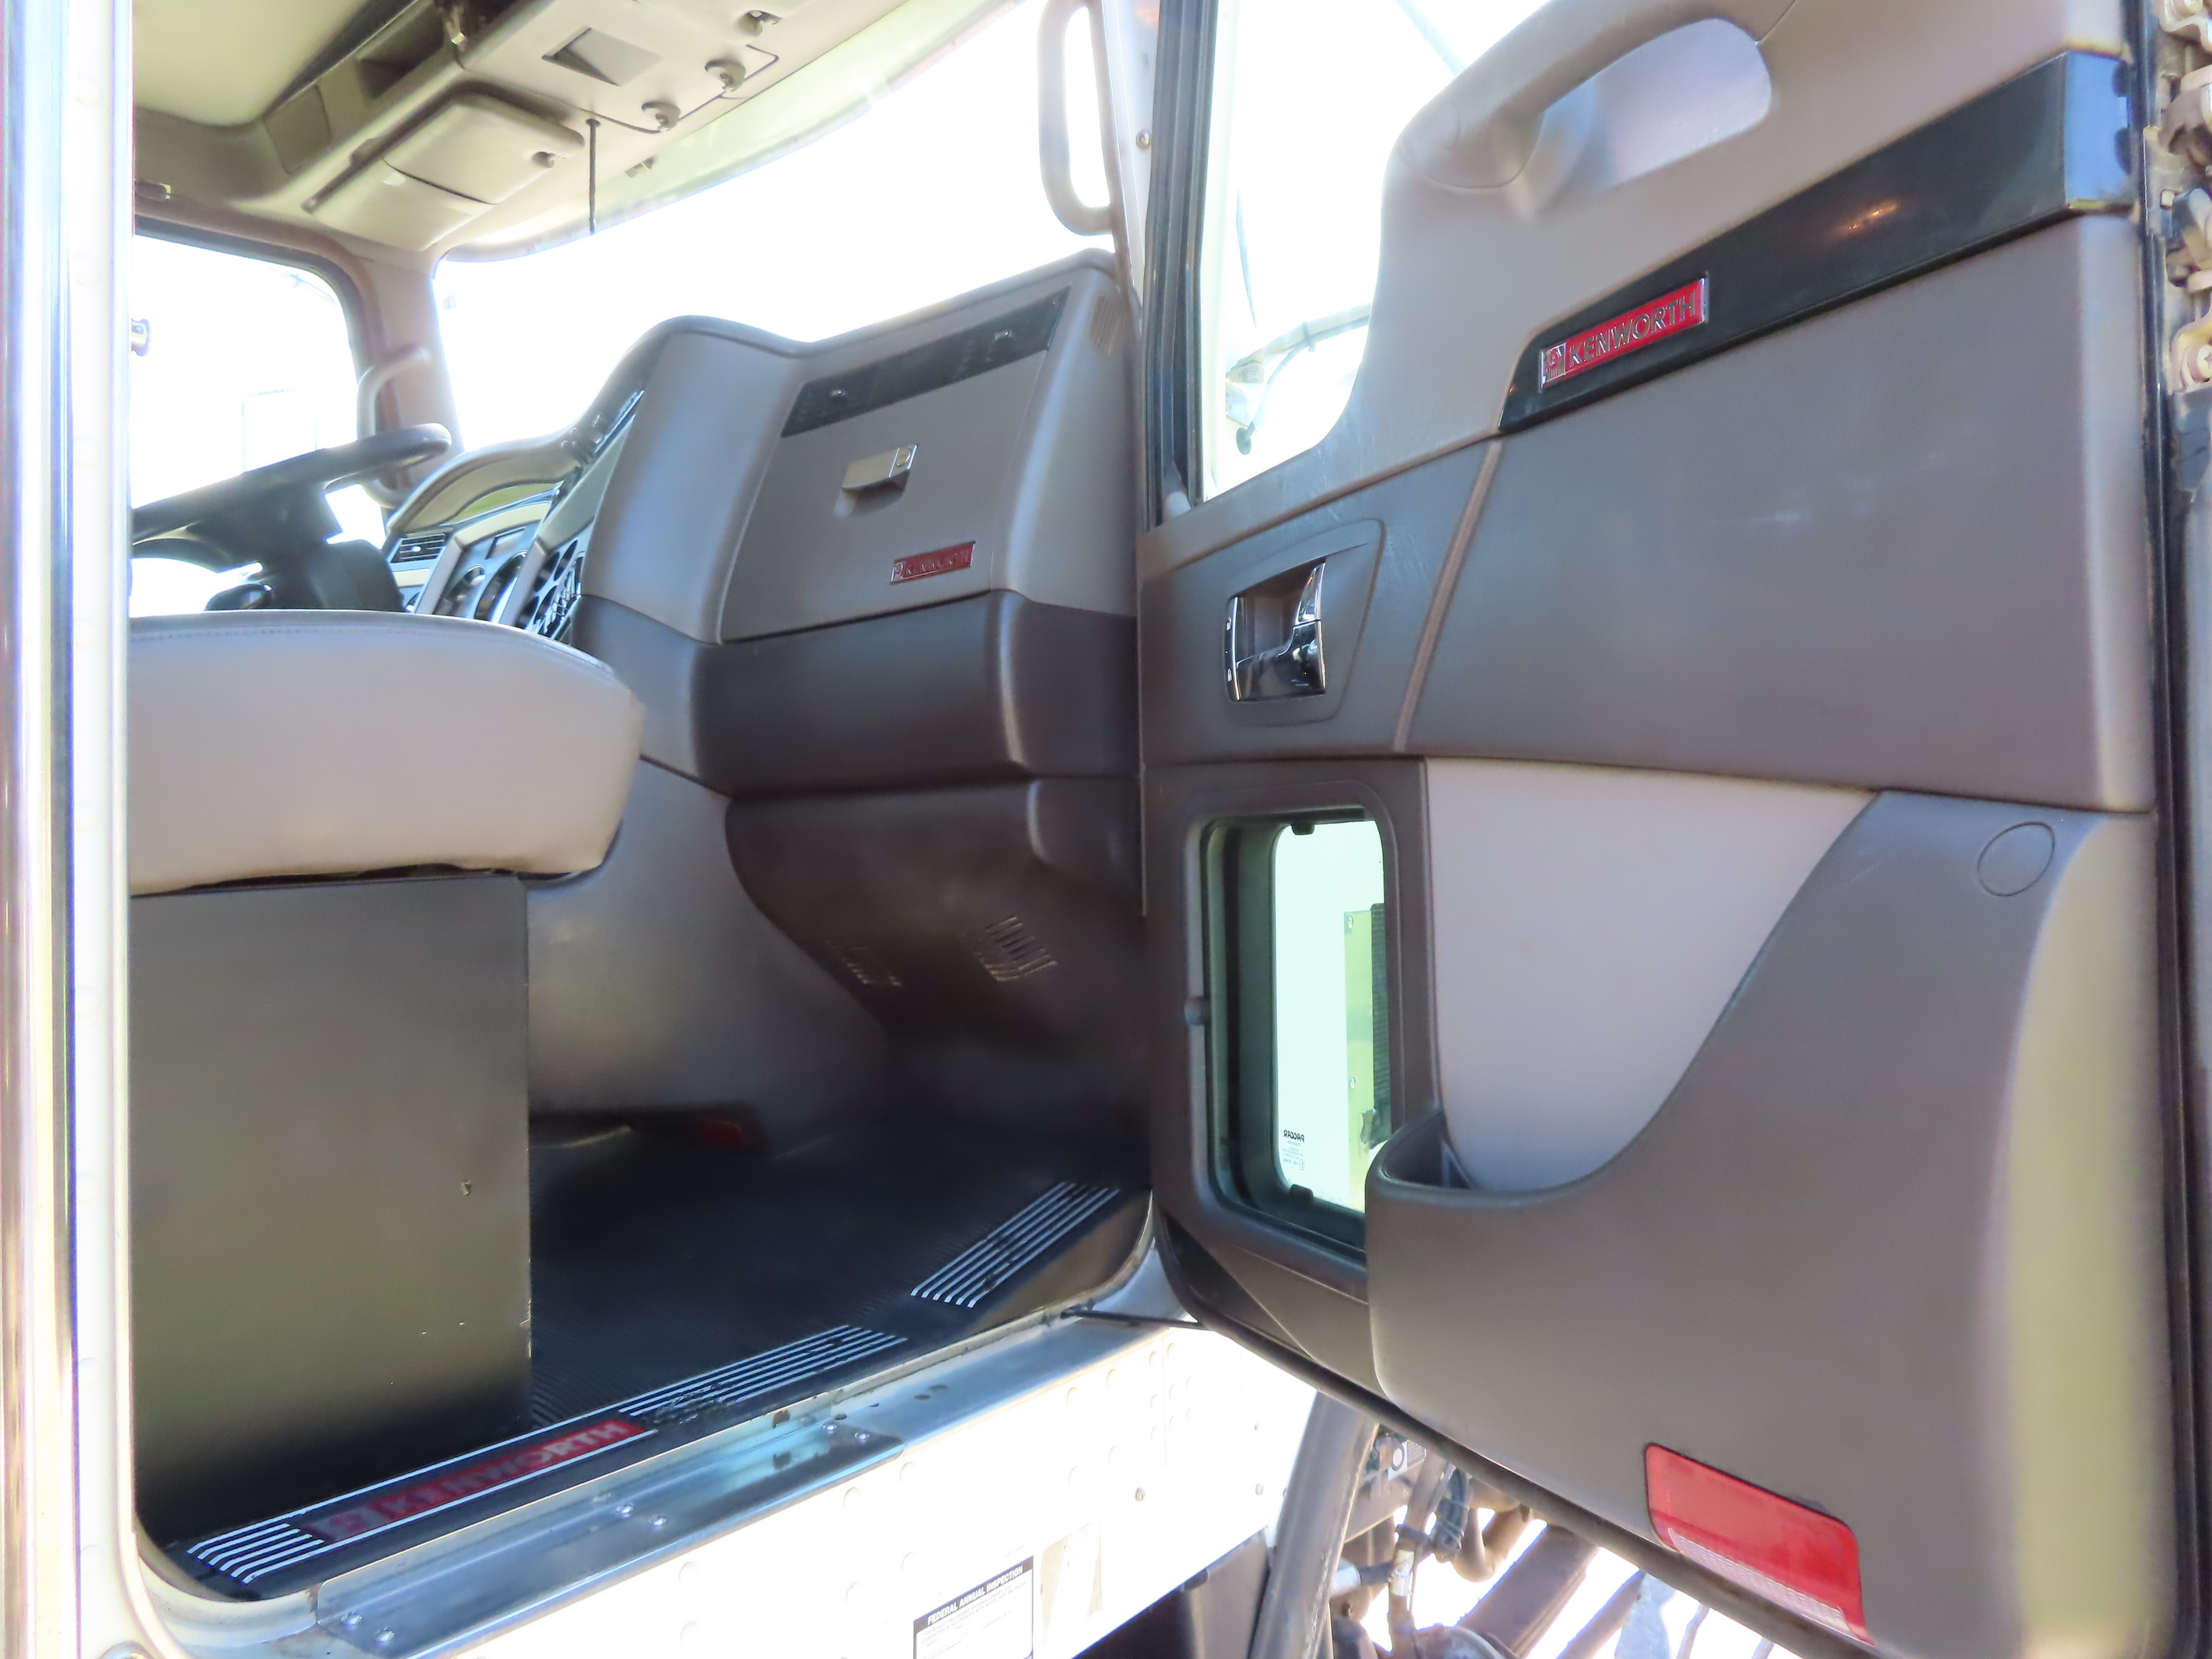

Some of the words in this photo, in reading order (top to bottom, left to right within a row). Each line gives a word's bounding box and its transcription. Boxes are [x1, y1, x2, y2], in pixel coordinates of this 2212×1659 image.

[1569, 292, 1697, 369] KENWORTH
[928, 1601, 959, 1626] FEDERAL
[959, 1586, 986, 1609] ANNUAL
[987, 1565, 1024, 1592] INSPECTION
